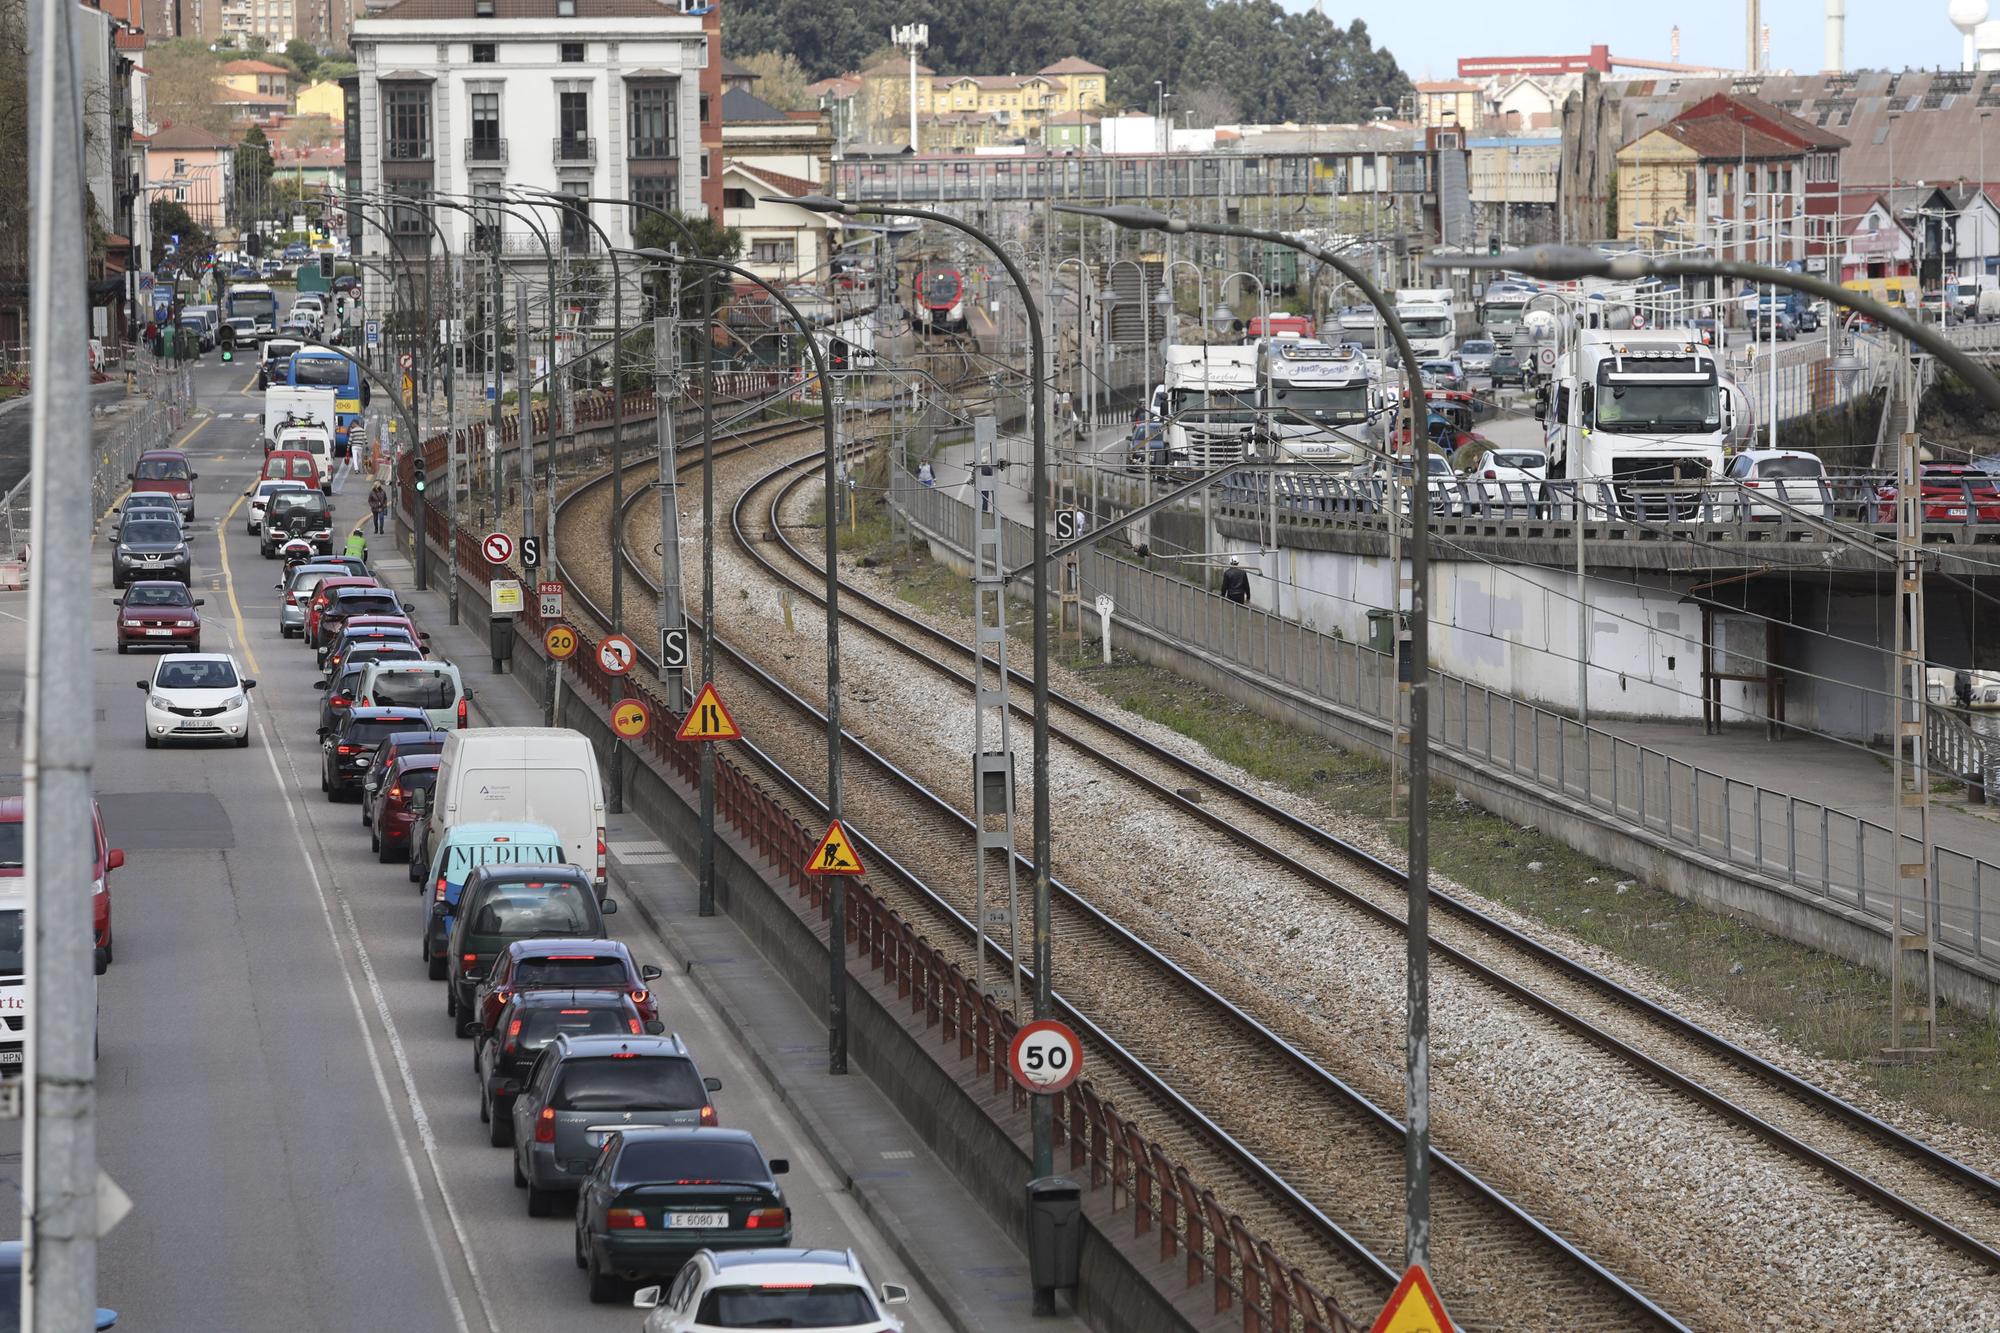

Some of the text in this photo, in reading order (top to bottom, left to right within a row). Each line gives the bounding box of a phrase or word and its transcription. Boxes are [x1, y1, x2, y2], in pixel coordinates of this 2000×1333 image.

[1058, 512, 1072, 538] S
[524, 539, 536, 565] S
[541, 584, 562, 592] N-632
[1103, 607, 1108, 616] 7
[551, 636, 571, 649] 20
[666, 631, 684, 665] S
[2, 1053, 21, 1062] HPN
[1026, 1046, 1067, 1070] 50
[717, 1215, 724, 1226] X
